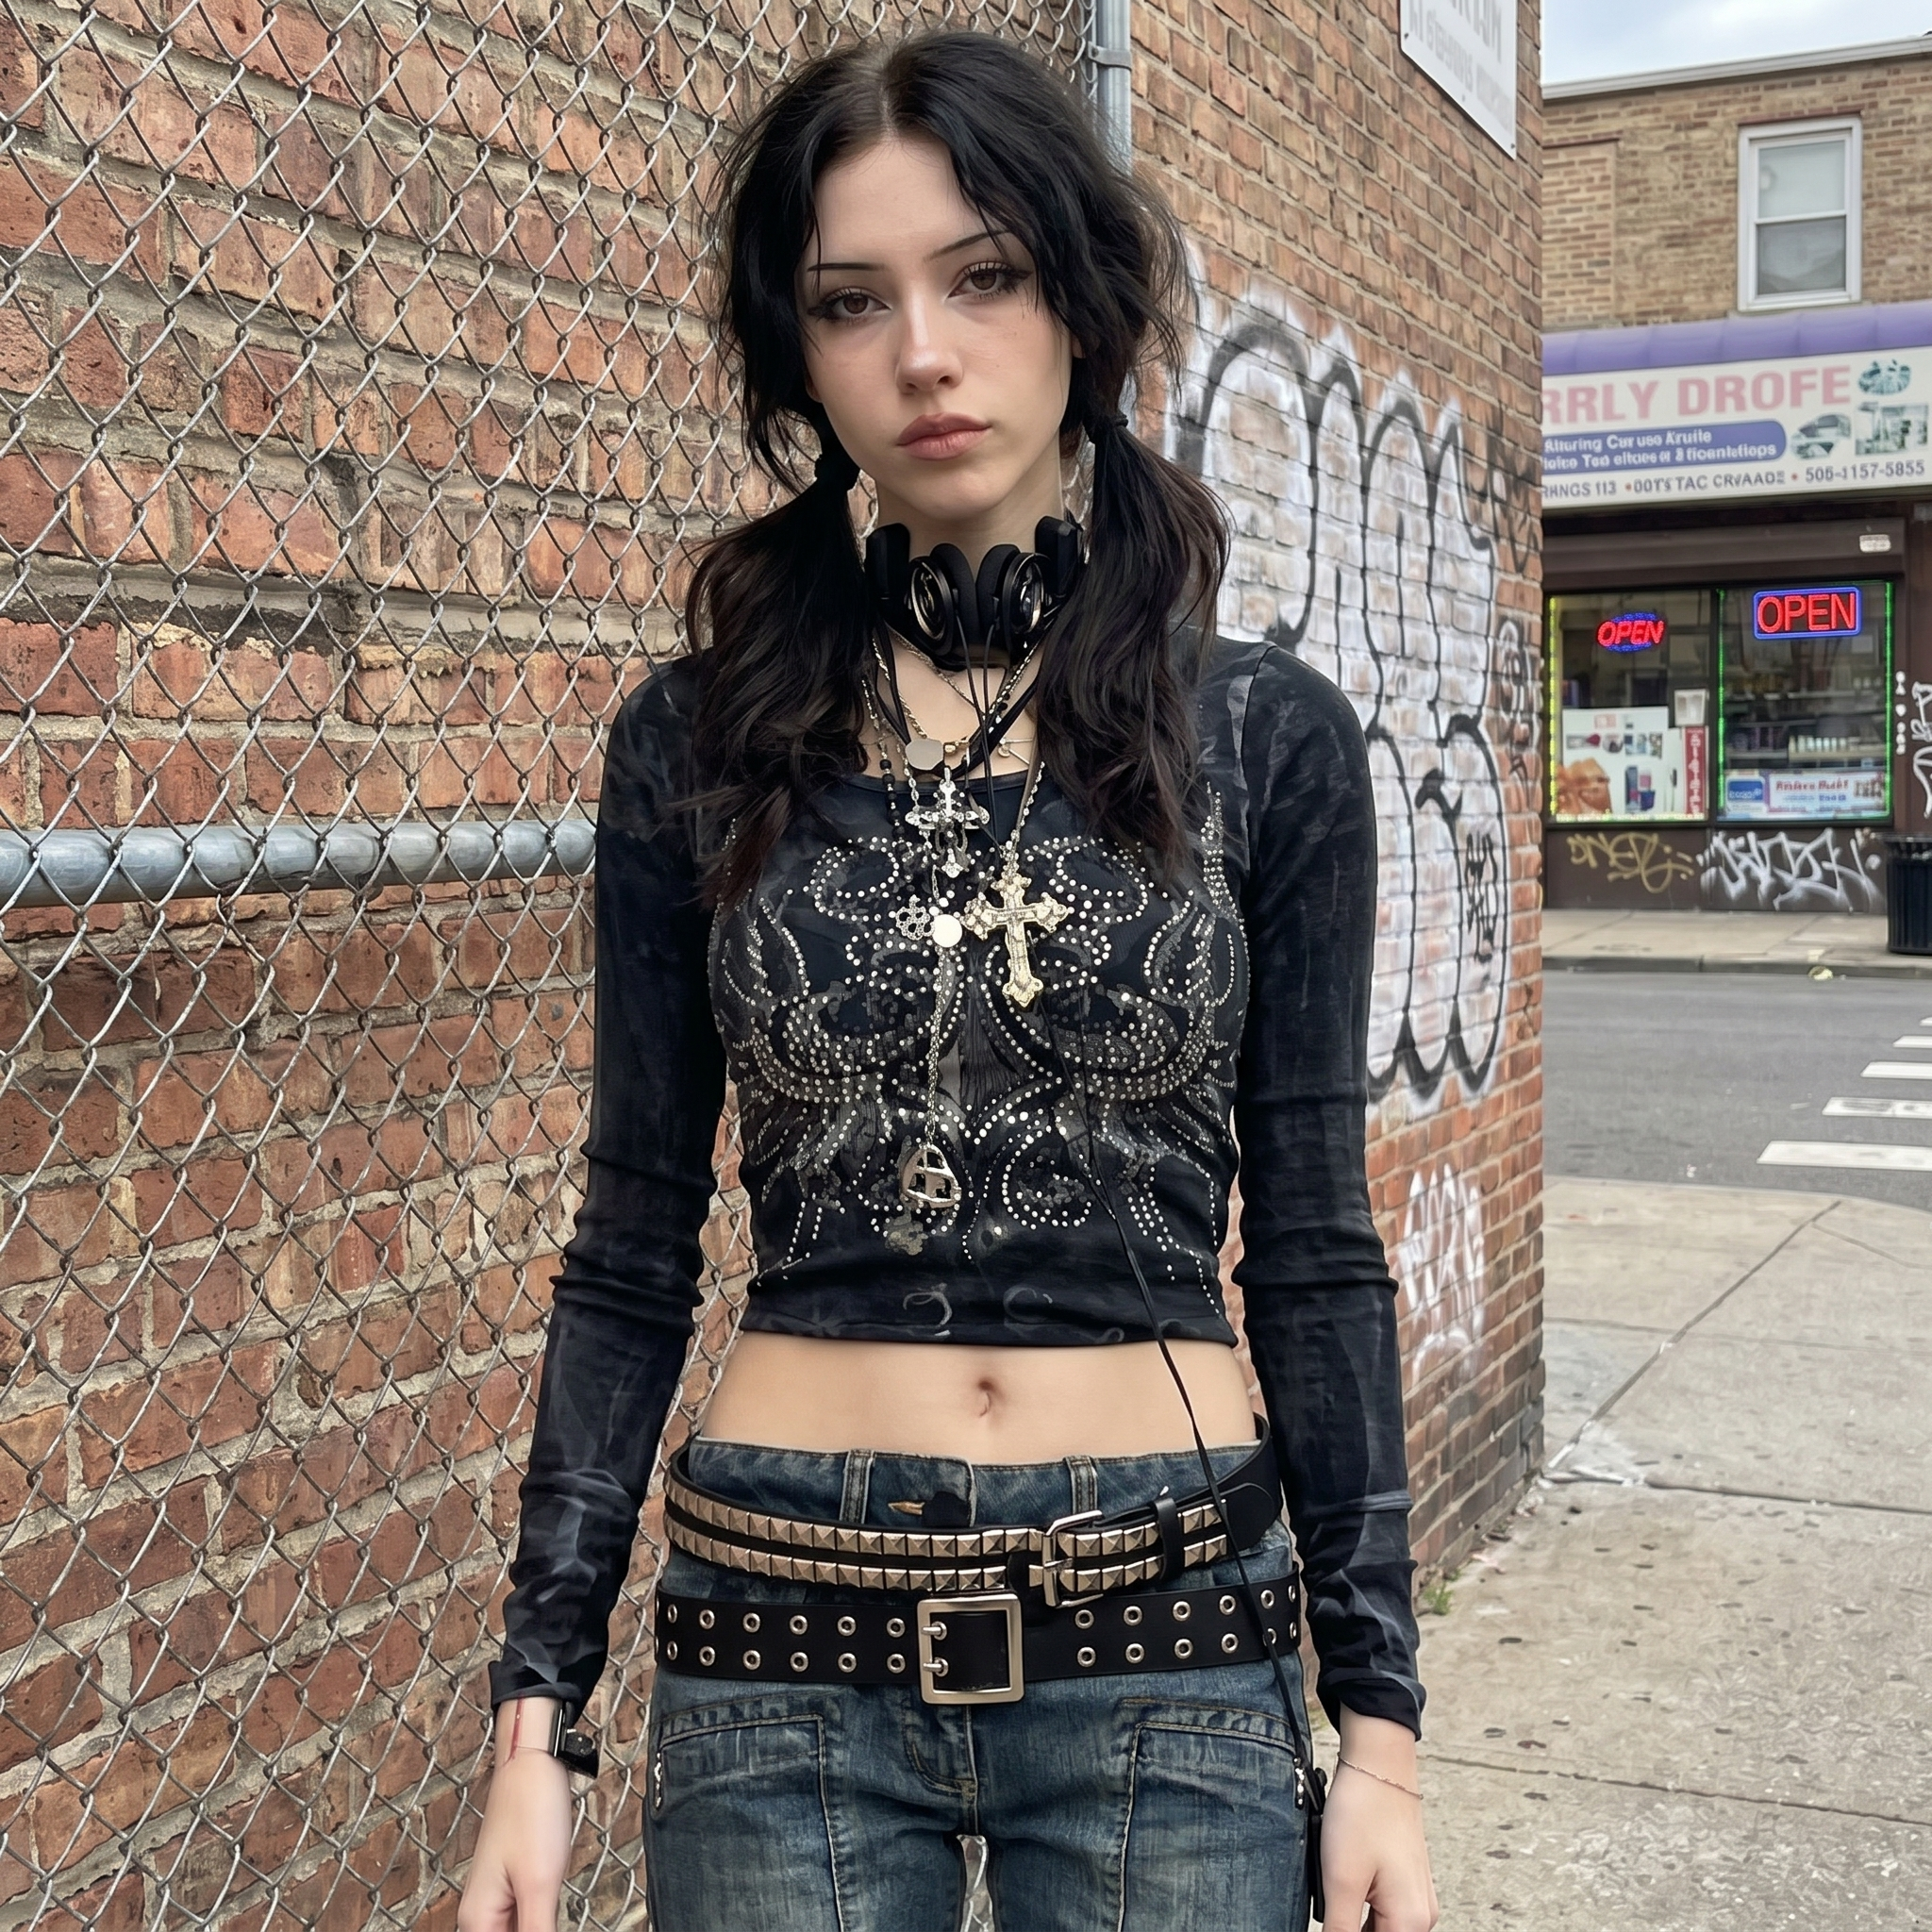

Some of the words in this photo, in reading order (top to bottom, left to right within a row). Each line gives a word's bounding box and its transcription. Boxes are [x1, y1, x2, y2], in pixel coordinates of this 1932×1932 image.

[1677, 365, 1851, 416] DROFE
[1597, 619, 1664, 647] OPEN
[1757, 592, 1856, 633] OPEN
